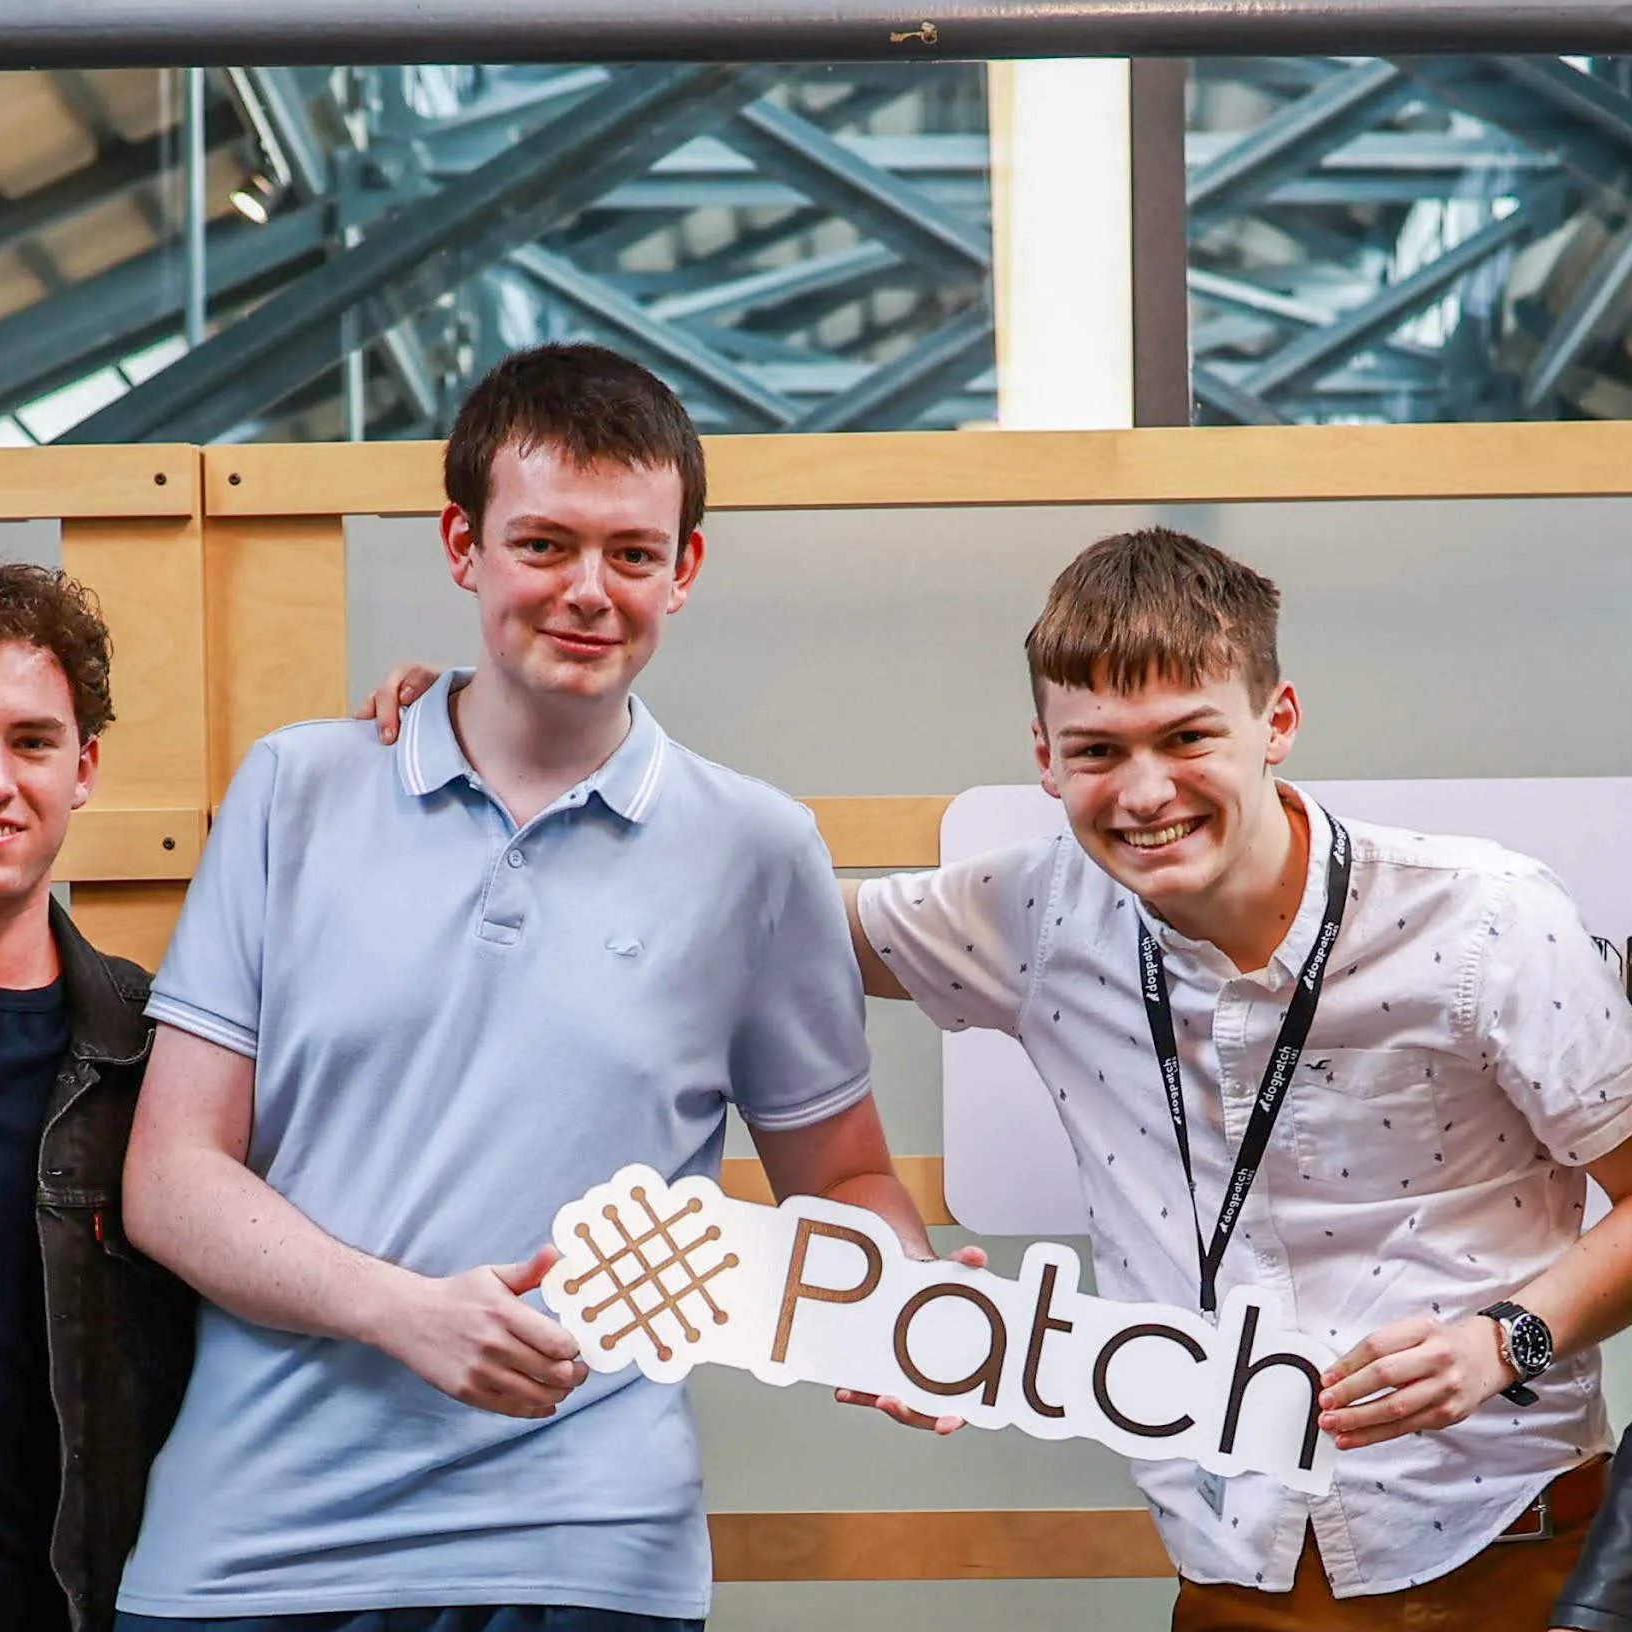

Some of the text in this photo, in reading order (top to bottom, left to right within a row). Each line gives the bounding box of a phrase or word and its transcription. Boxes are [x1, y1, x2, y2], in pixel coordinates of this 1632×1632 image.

[1140, 936, 1159, 993] dogpatch
[1307, 921, 1335, 982] dogpatch
[1162, 1057, 1180, 1115] dogpatch
[1262, 1046, 1292, 1102] dogpatch
[1221, 1167, 1249, 1223] dogpatch
[769, 1217, 1323, 1471] Patch
